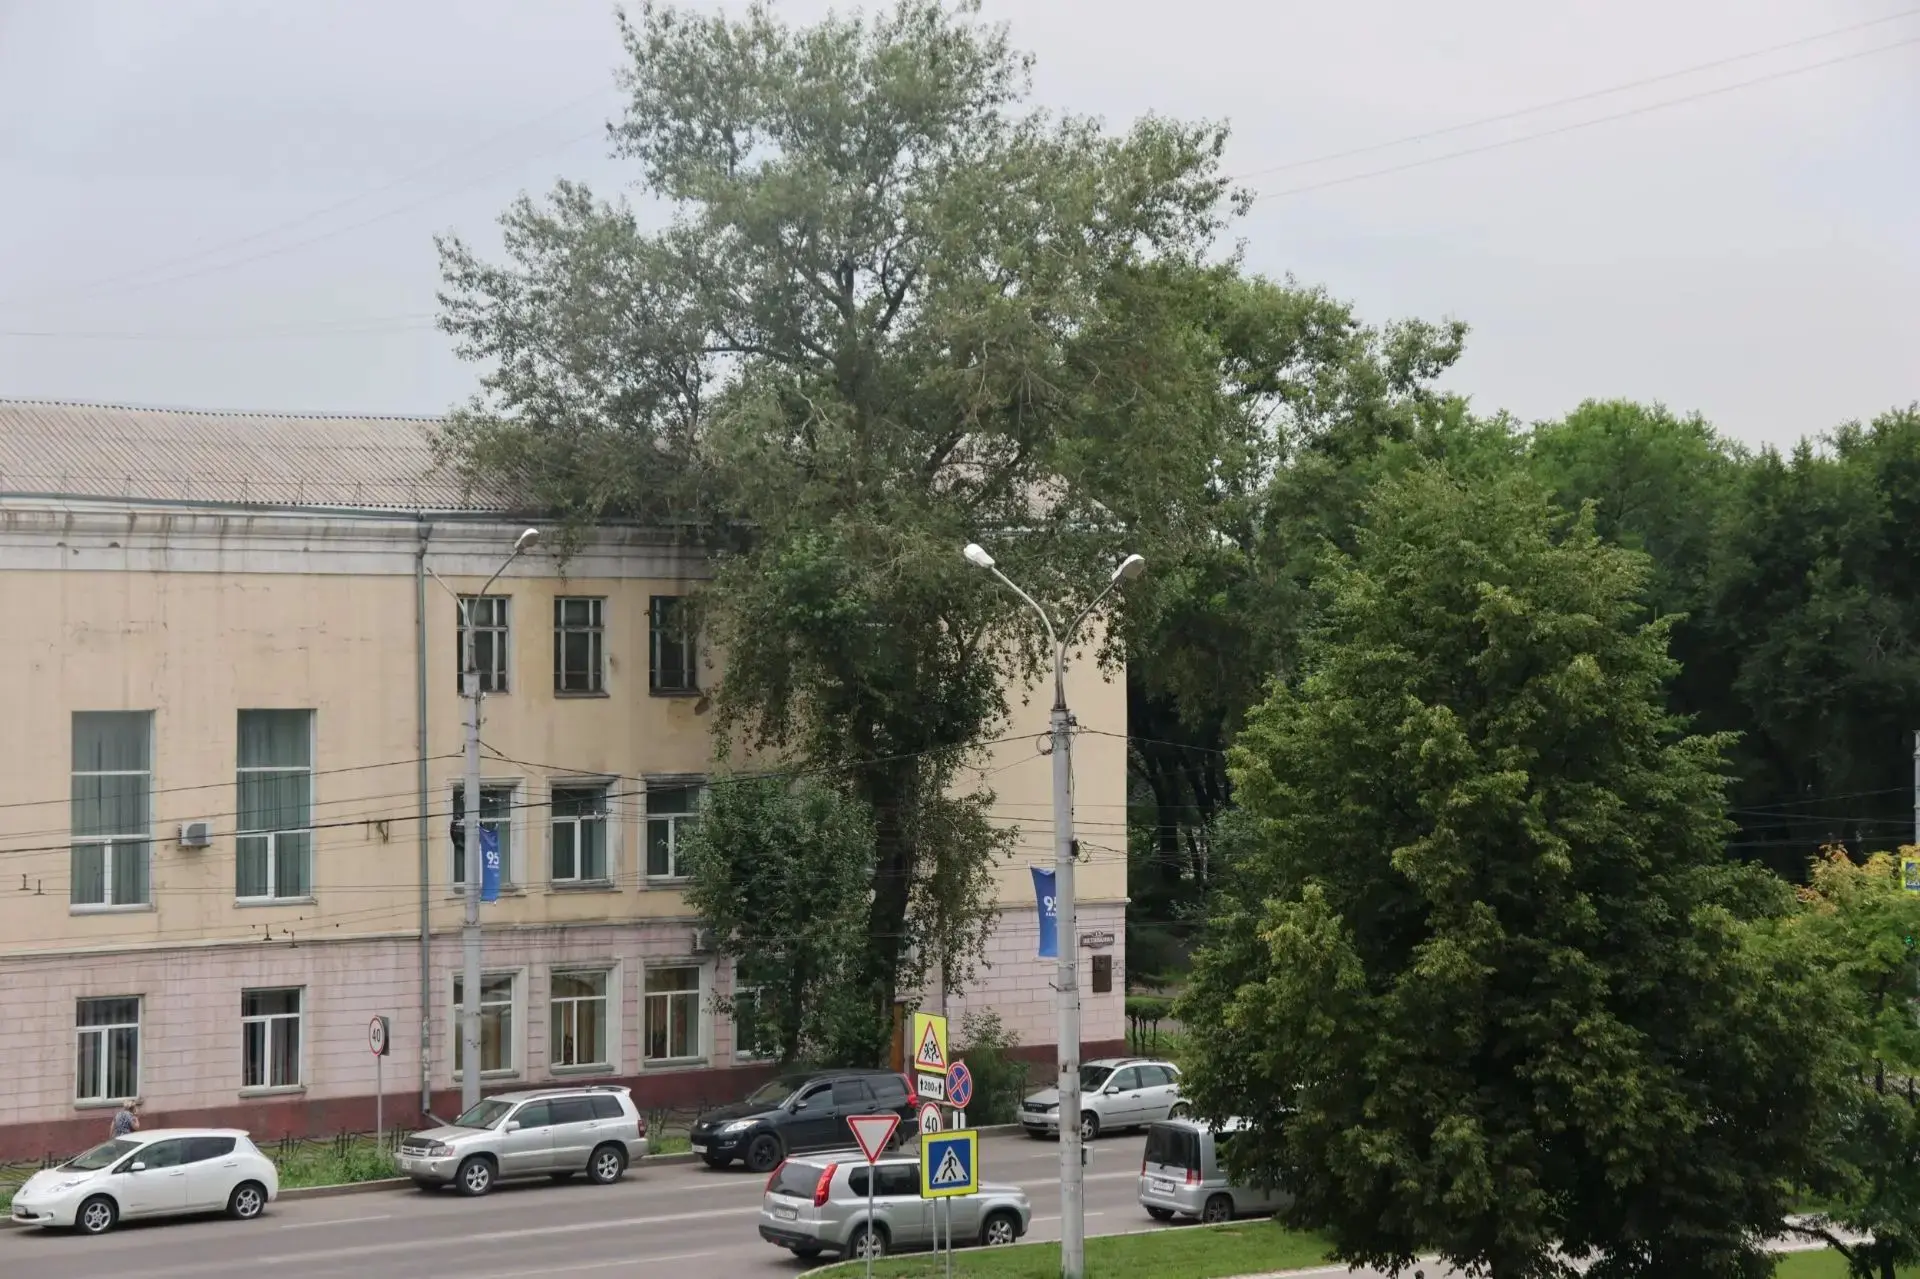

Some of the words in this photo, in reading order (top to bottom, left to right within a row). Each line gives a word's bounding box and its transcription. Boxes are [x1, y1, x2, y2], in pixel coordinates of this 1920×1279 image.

[486, 851, 500, 865] 95
[372, 1028, 380, 1042] 40
[925, 1116, 937, 1133] 40
